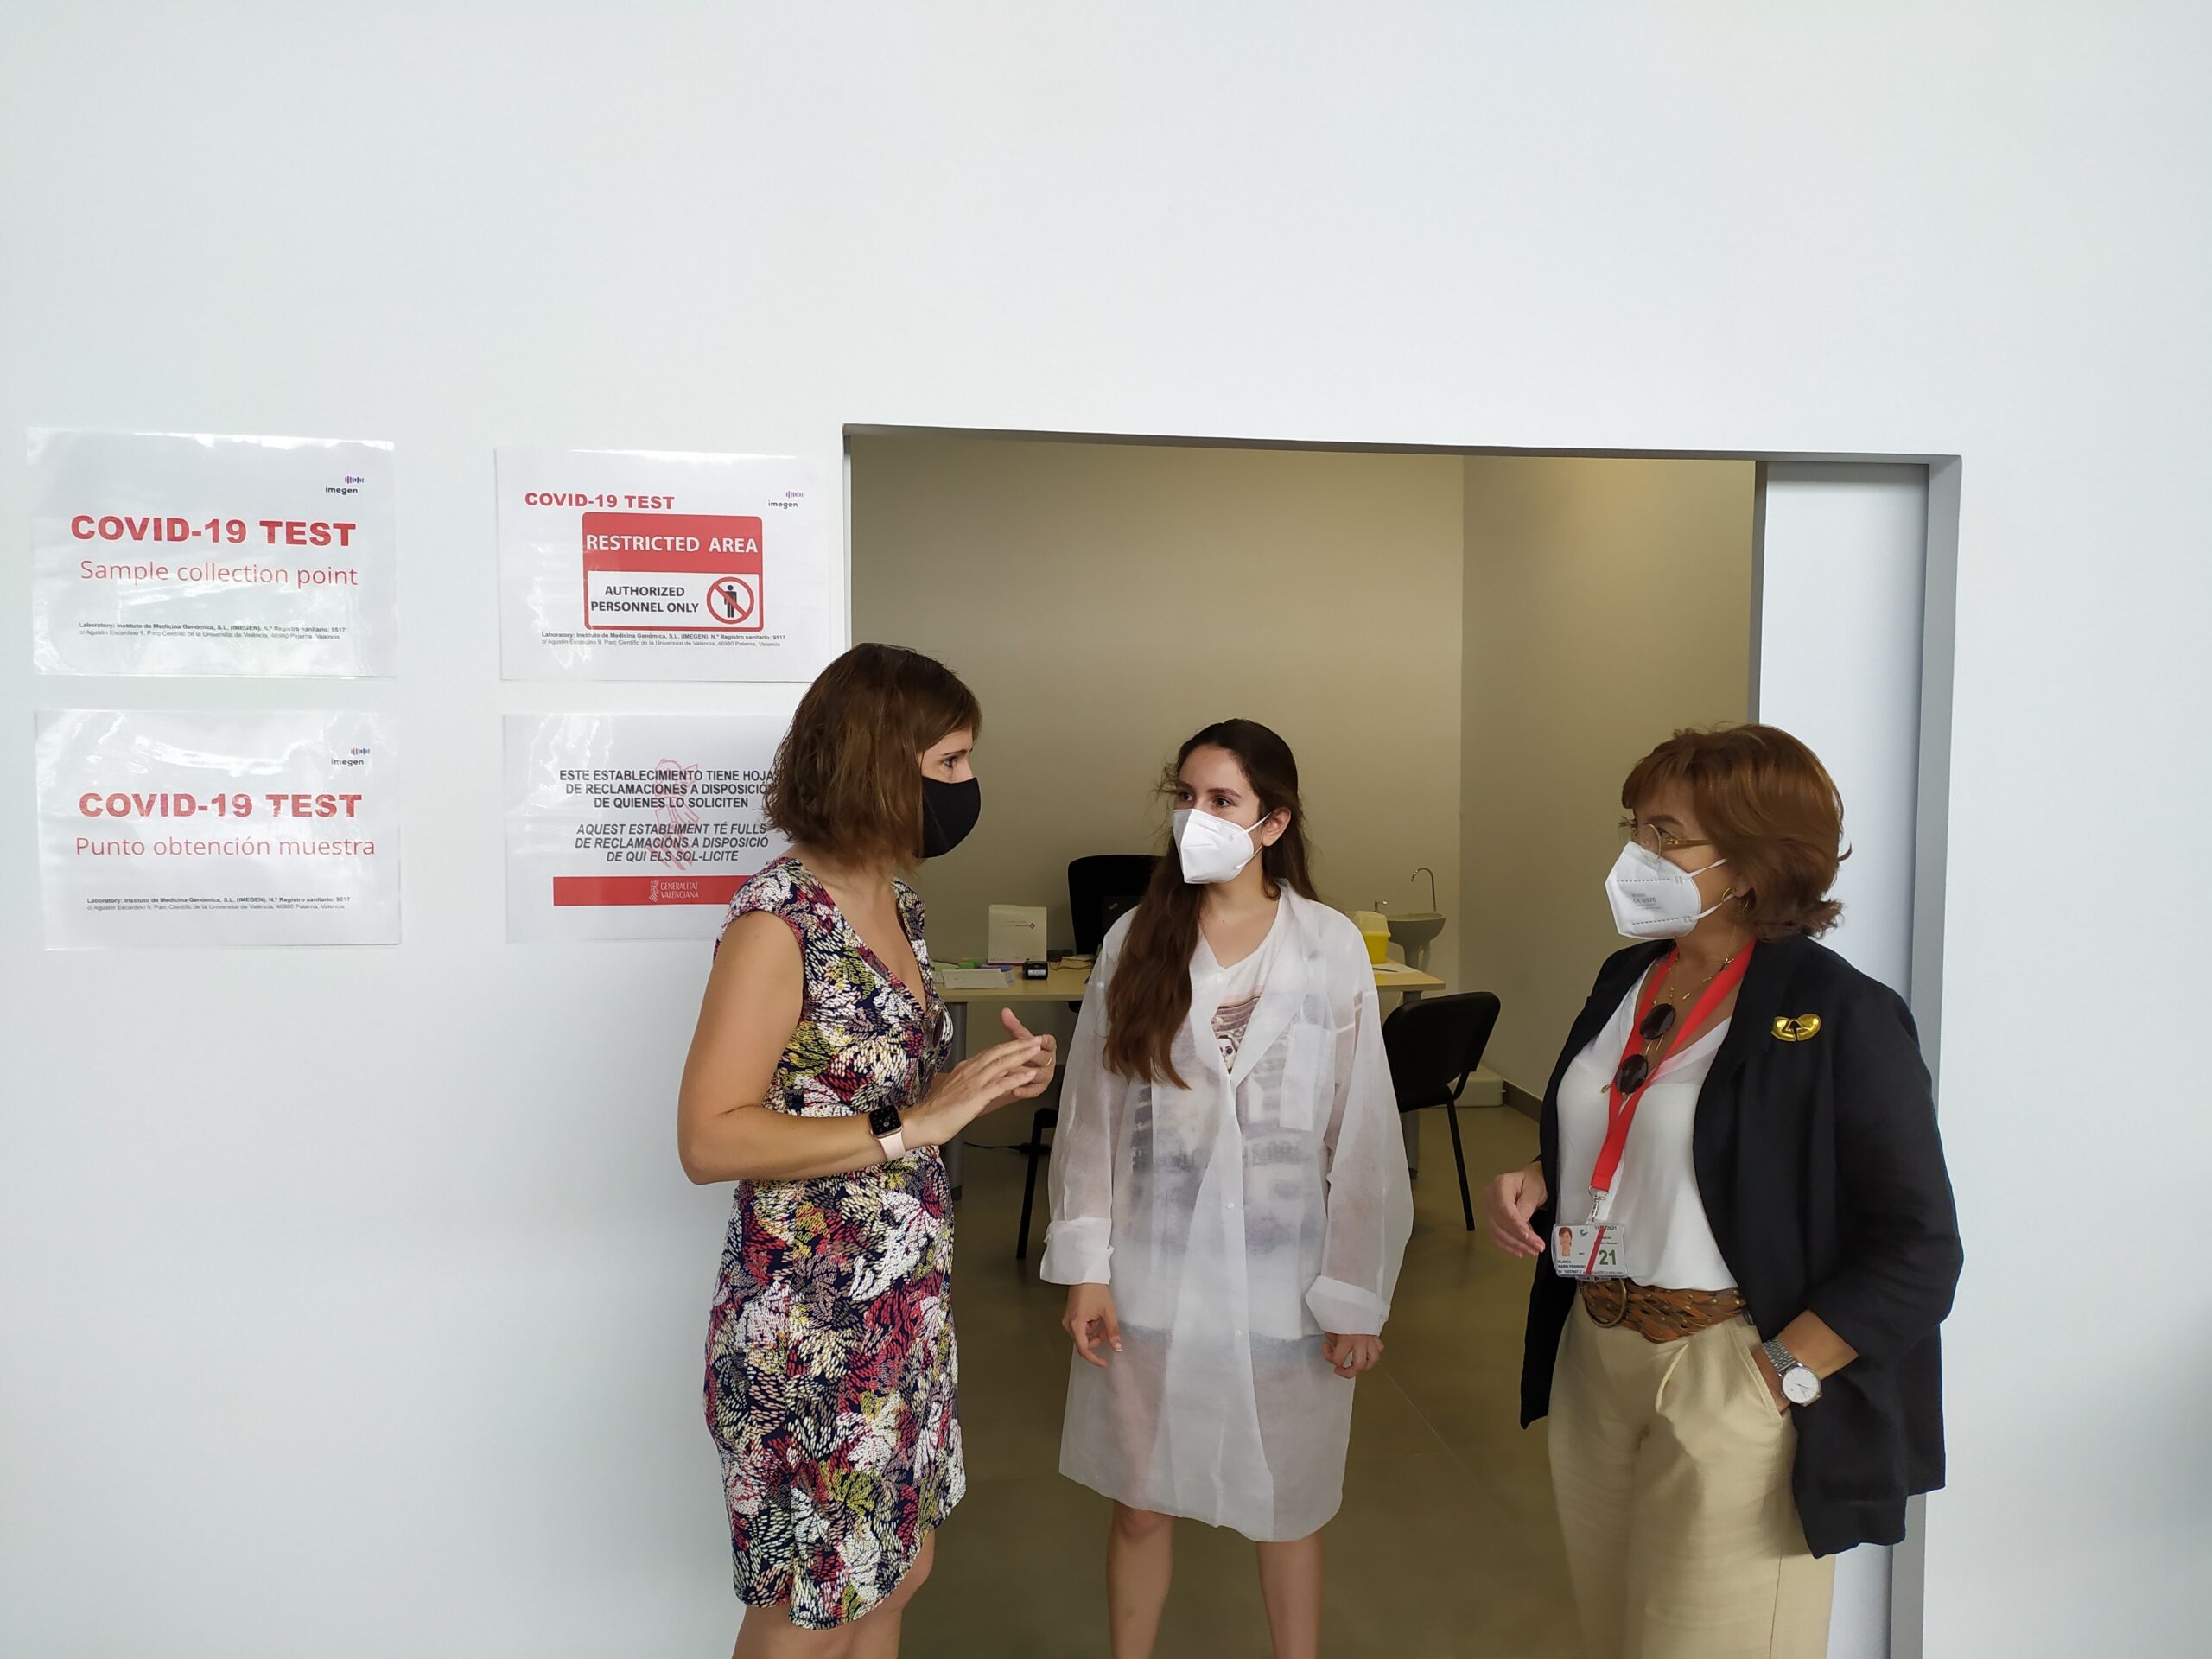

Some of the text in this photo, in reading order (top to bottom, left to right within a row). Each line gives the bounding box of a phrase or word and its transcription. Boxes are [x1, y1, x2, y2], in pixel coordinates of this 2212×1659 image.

[325, 485, 359, 496] imegen
[524, 492, 675, 510] COVID-19 TEST
[767, 499, 798, 510] imegen
[70, 514, 357, 547] COVID-19 TEST
[586, 535, 759, 554] RESTRICTED AREA
[79, 560, 359, 589] Sample collection point
[605, 586, 685, 598] AUTHORIZED
[590, 601, 699, 613] PERSONNEL ONLY
[331, 759, 365, 767] imegen
[559, 769, 780, 781] ESTE ESTABLECIMIENTO TIENE HOJA
[565, 781, 771, 795] DE RECLAMACIONES A DISPOSICIÓ
[79, 792, 362, 817] COVID-19 TEST
[594, 797, 748, 809] DE QUIENES LO SOLICITEN
[575, 820, 767, 836] AQUEST ESTABLIMENT TÉ FULLS
[76, 836, 375, 855] Punto obtención muestra
[575, 834, 769, 849] DE RECLAMACIÓNS A DISPOSICIÓ
[606, 850, 623, 862] DE
[626, 850, 647, 862] QUI
[649, 850, 672, 862] ELS
[660, 881, 699, 891] GENERALITAT
[660, 890, 699, 899] VALENCIANA
[1599, 1249, 1617, 1266] 21
